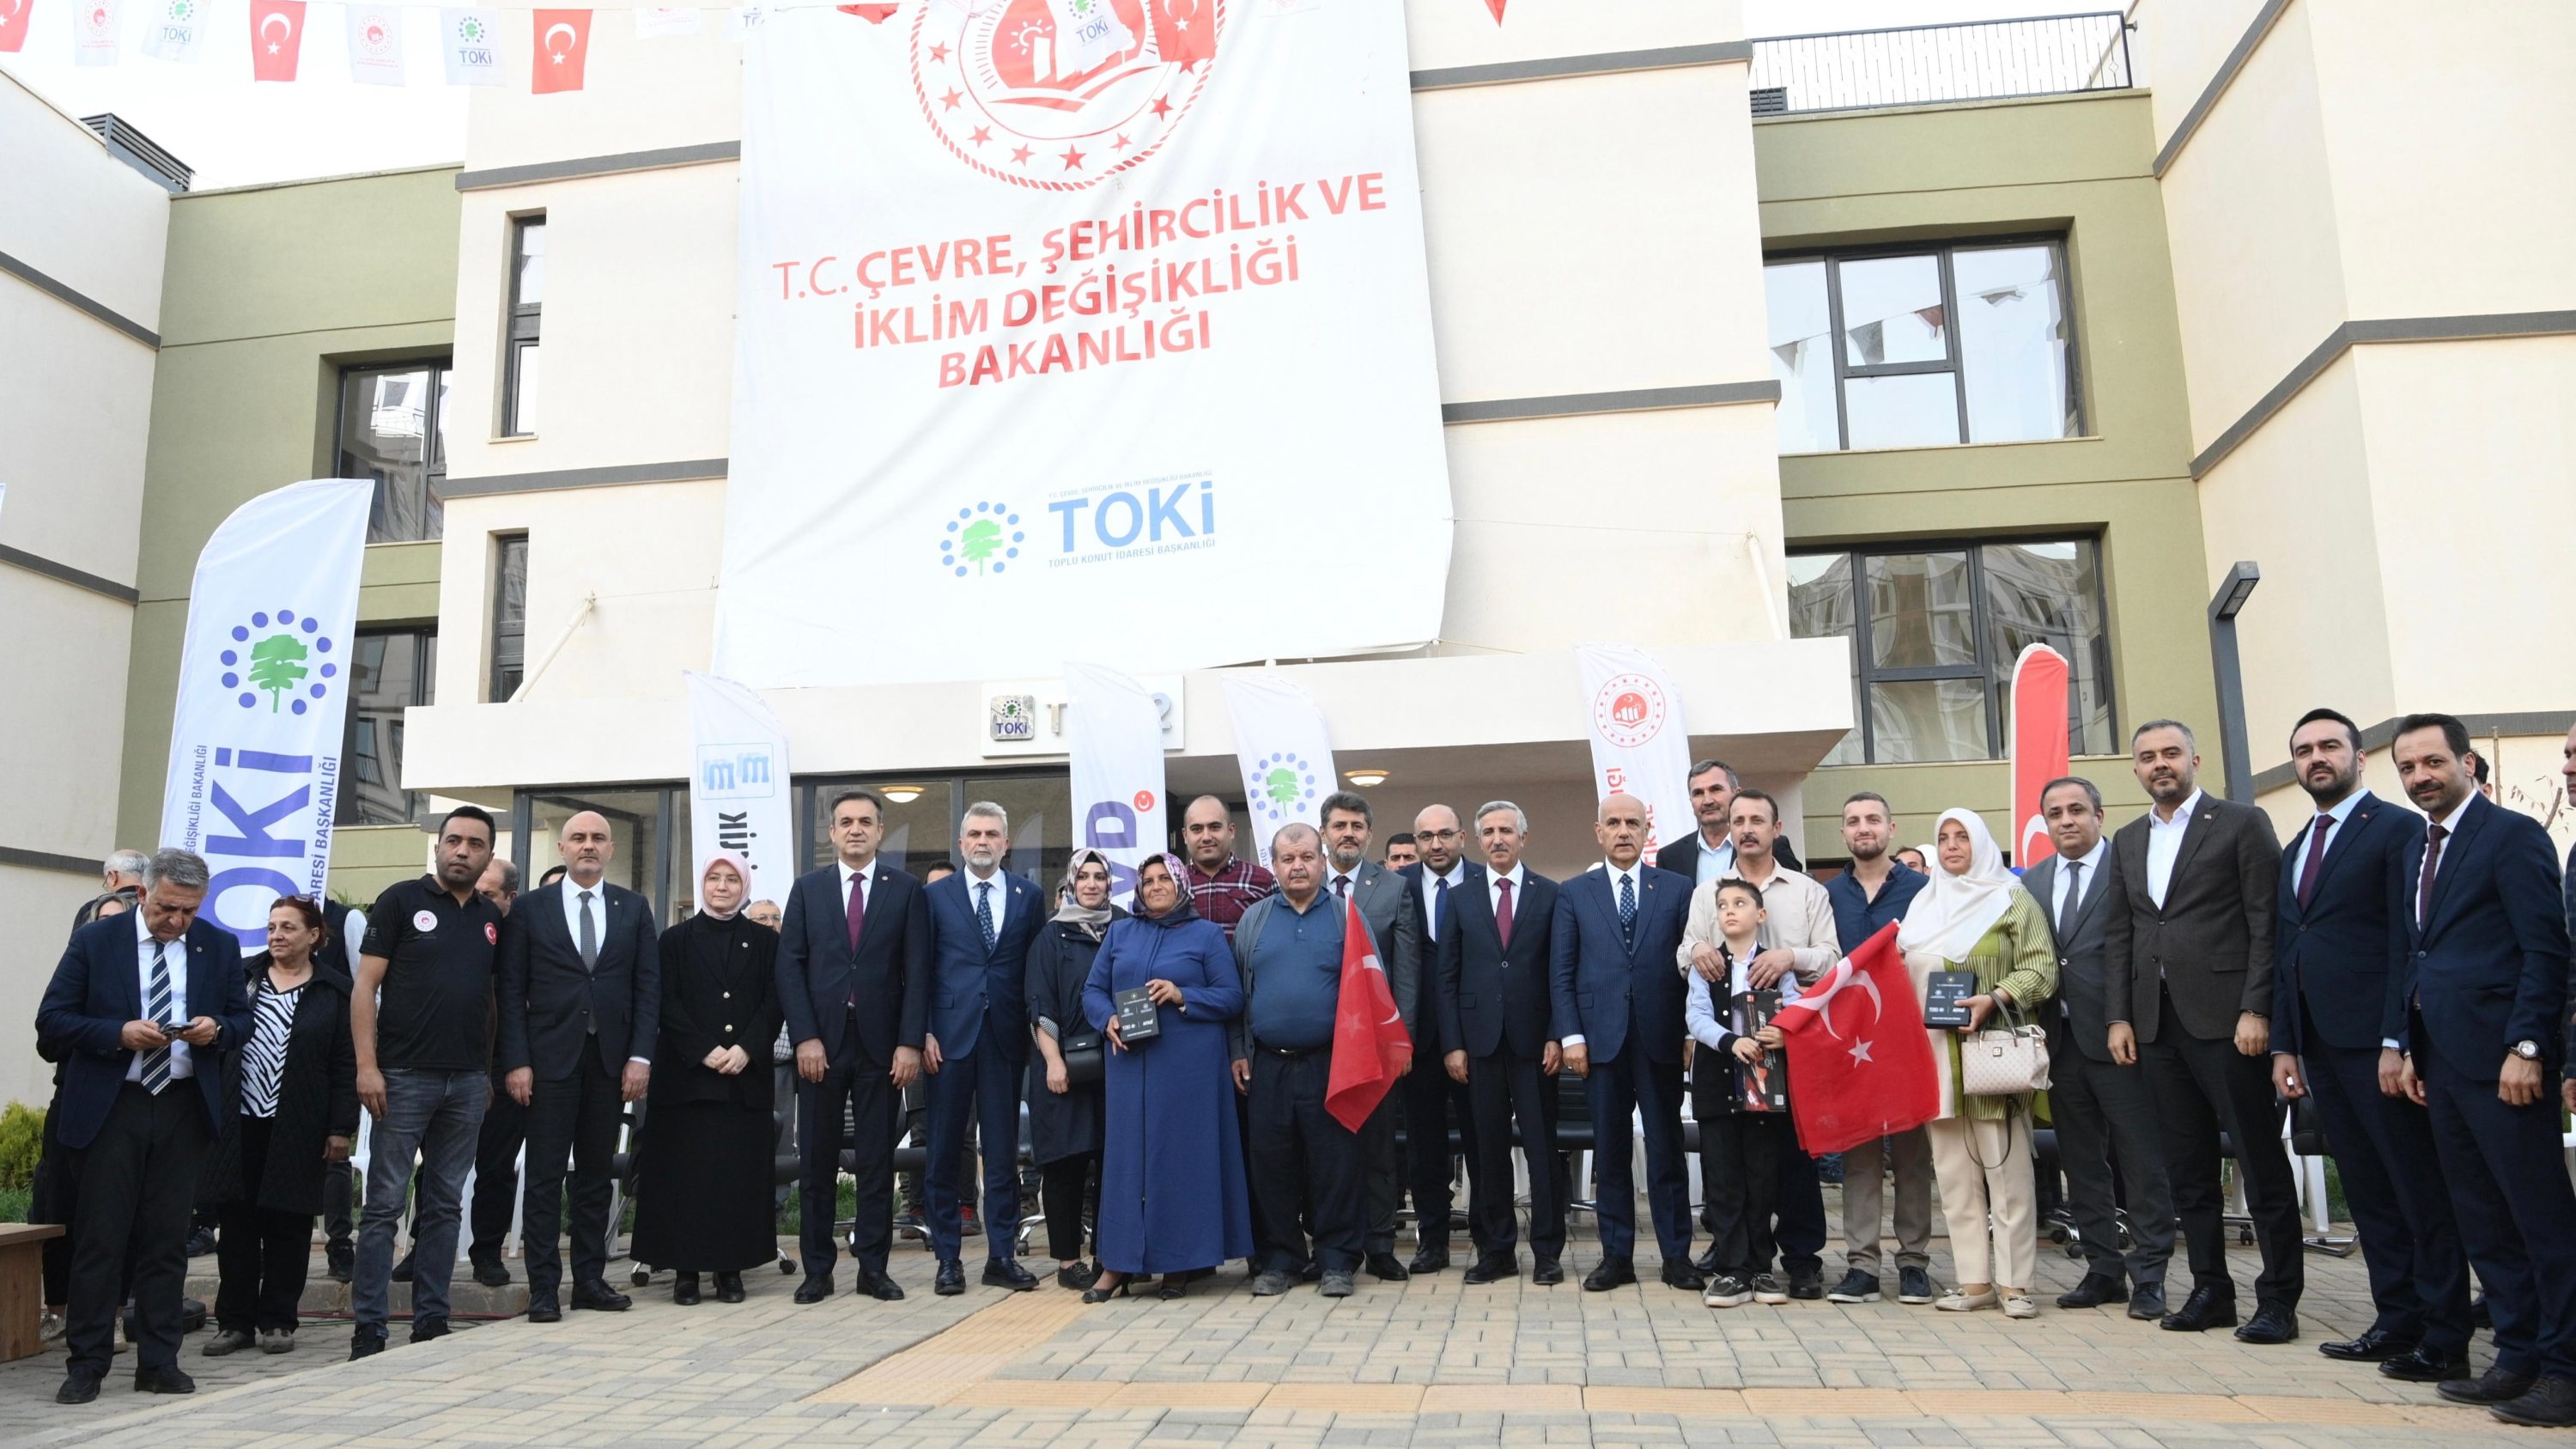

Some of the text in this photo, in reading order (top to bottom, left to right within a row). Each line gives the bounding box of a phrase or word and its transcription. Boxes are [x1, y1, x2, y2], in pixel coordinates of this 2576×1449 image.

[773, 172, 1387, 300] T.C. ÇEVRE, ŞEHİRCİLİK VE
[854, 234, 1299, 350] İKLİM DEĞİŞİKLİĞİ
[939, 307, 1211, 389] BAKANLIĞI
[1048, 556, 1078, 568] TOPLU
[1081, 551, 1113, 564] KONUT
[183, 745, 208, 856] EĞİŞİKLİĞİ BAKANLIĞI
[310, 756, 337, 902] ARESİ BAŞKANLIĞI
